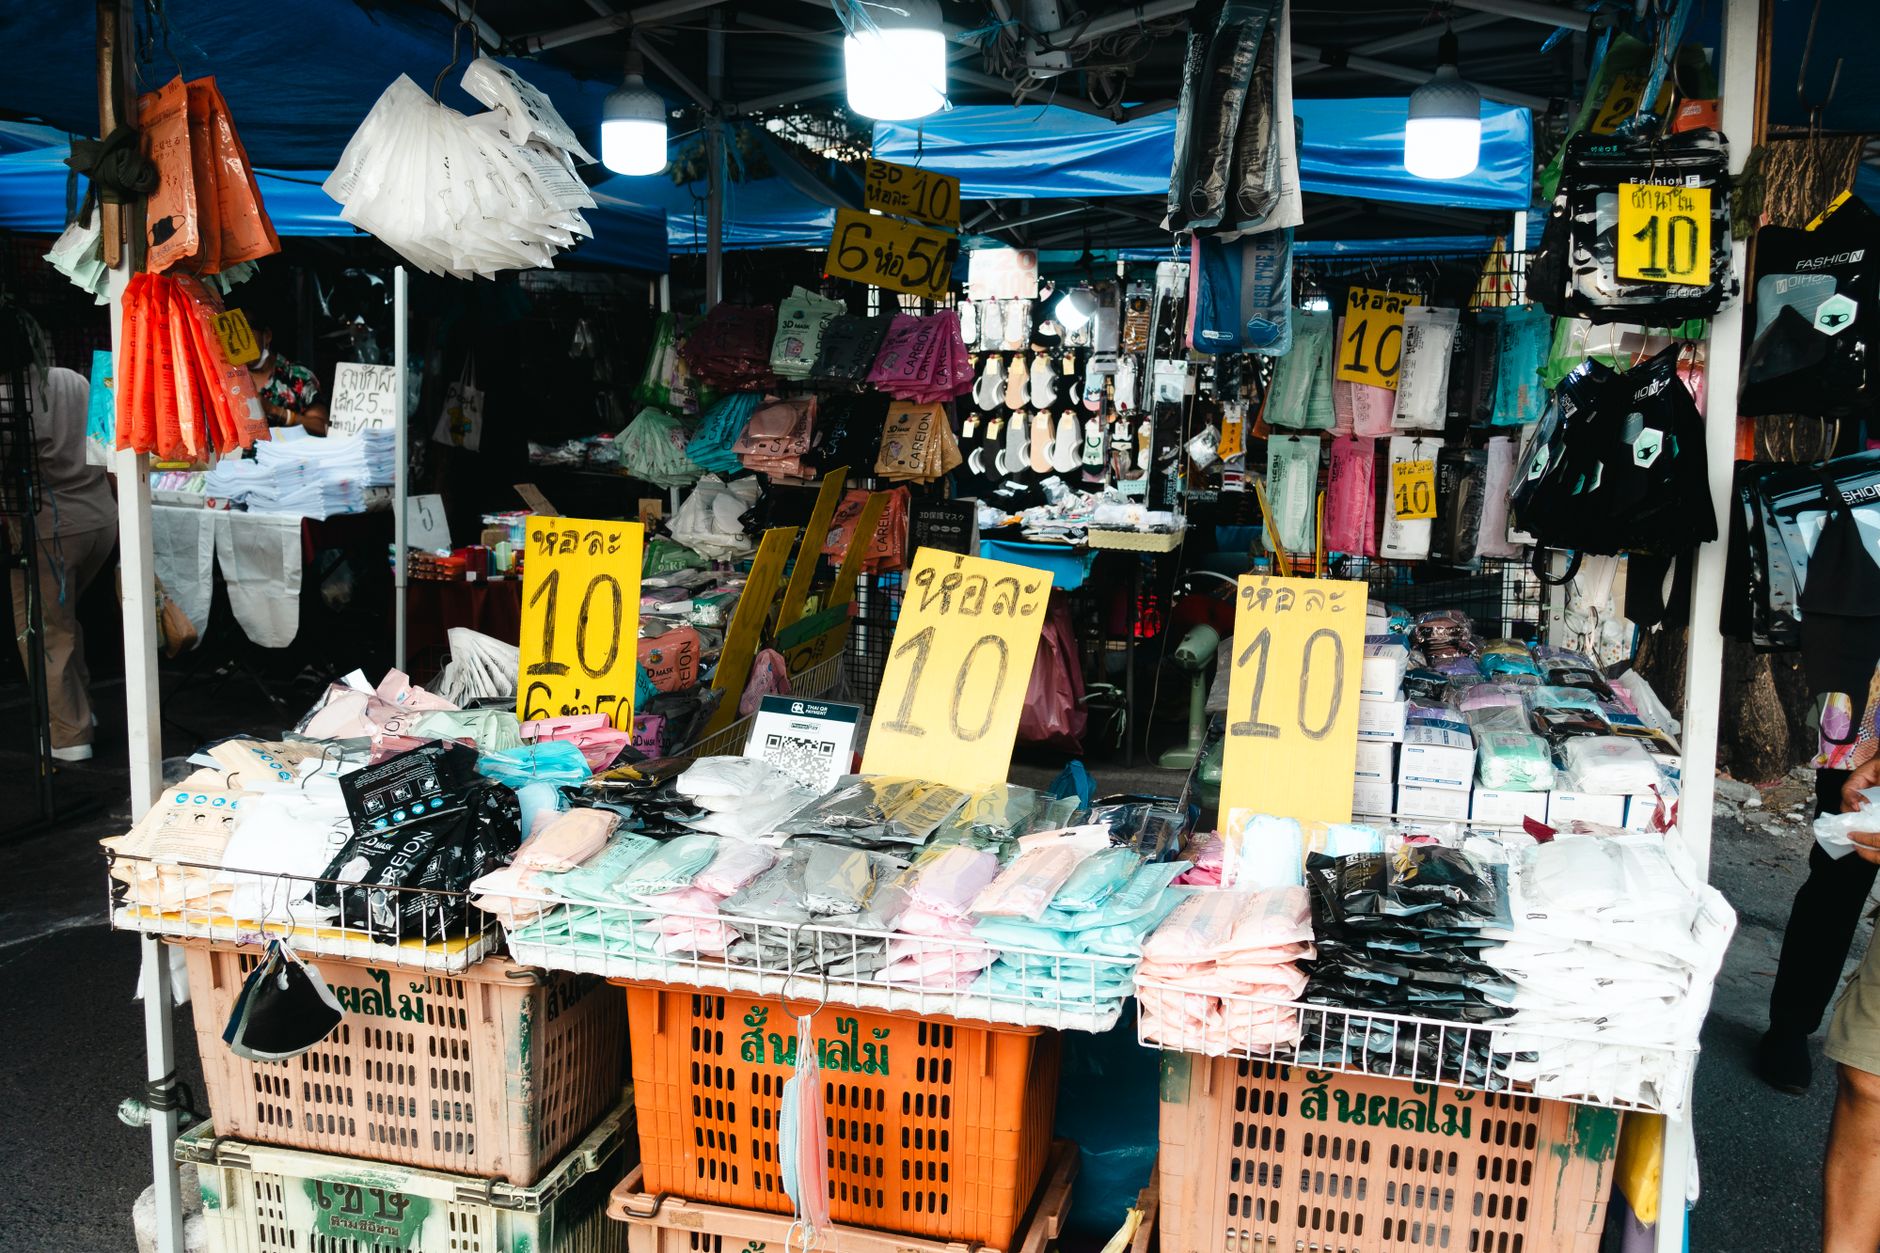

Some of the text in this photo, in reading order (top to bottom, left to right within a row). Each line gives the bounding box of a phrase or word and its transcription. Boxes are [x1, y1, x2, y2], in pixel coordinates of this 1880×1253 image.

[869, 162, 902, 184] 3D
[908, 174, 951, 220] 10
[837, 222, 951, 292] 6 ห่อ 50
[1633, 215, 1699, 278] 10
[1796, 249, 1865, 270] FASHION
[219, 313, 250, 357] 20
[782, 320, 794, 329] 3D
[1406, 326, 1415, 355] KF94
[904, 324, 934, 376] CAREION
[1343, 320, 1404, 379] 10
[354, 392, 379, 413] 25
[909, 411, 933, 470] CAREION
[1396, 481, 1430, 516] 10
[531, 519, 622, 556] ห่อละ
[915, 556, 1041, 617] ห่อละ
[1241, 577, 1346, 613] ห่อละ
[526, 568, 622, 680] 10
[656, 667, 674, 678] MASK
[881, 625, 1009, 742] 10
[1230, 627, 1345, 741] 10
[375, 839, 394, 851] MASK
